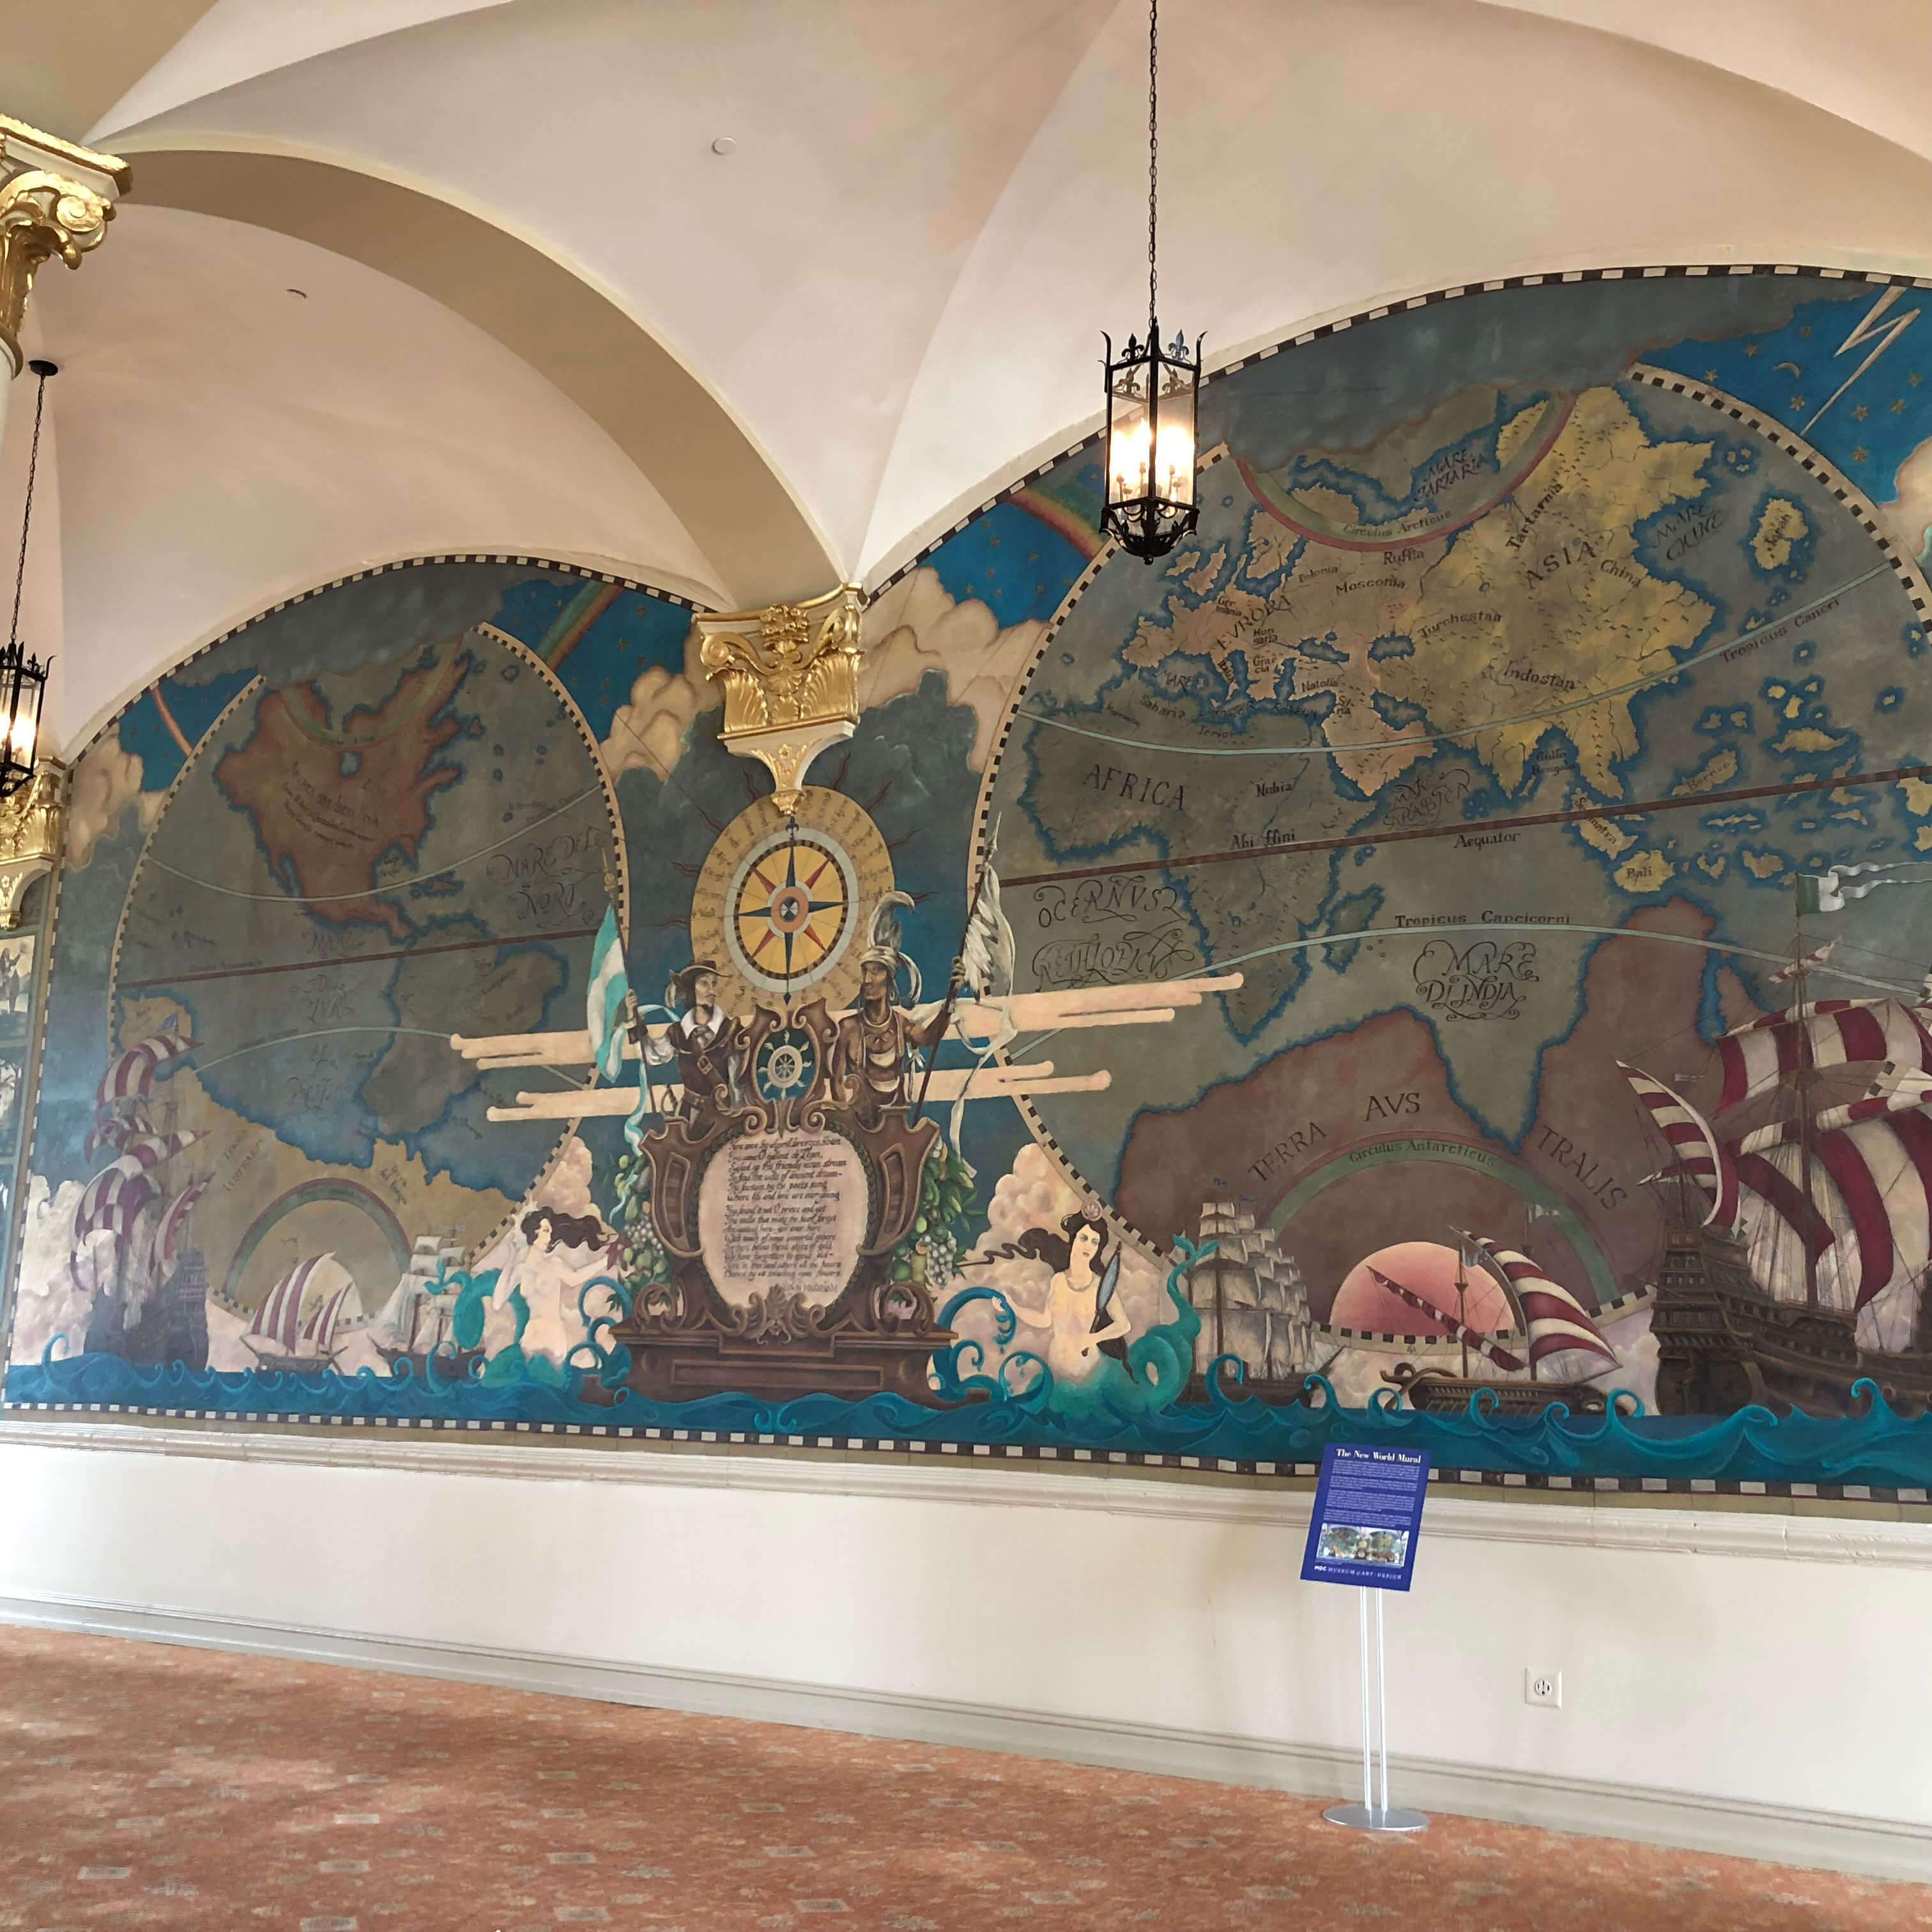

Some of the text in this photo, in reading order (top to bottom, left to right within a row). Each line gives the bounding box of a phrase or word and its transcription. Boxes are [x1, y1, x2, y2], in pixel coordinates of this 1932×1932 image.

[1524, 542, 1596, 589] ASIA
[1600, 560, 1642, 587] China
[1301, 678, 1338, 693] Natolia
[1085, 764, 1185, 811] AFRICA
[1256, 780, 1292, 798] Nubia
[1574, 797, 1617, 845] Smatra
[1453, 832, 1521, 852] Aequator
[1395, 913, 1467, 928] Tropicus
[1413, 939, 1539, 982] MARE
[1248, 1092, 1629, 1211] TERRA AVS TRALIS
[1349, 1140, 1498, 1166] Circulus Antarcticus
[1336, 1448, 1422, 1464] The New World Mural
